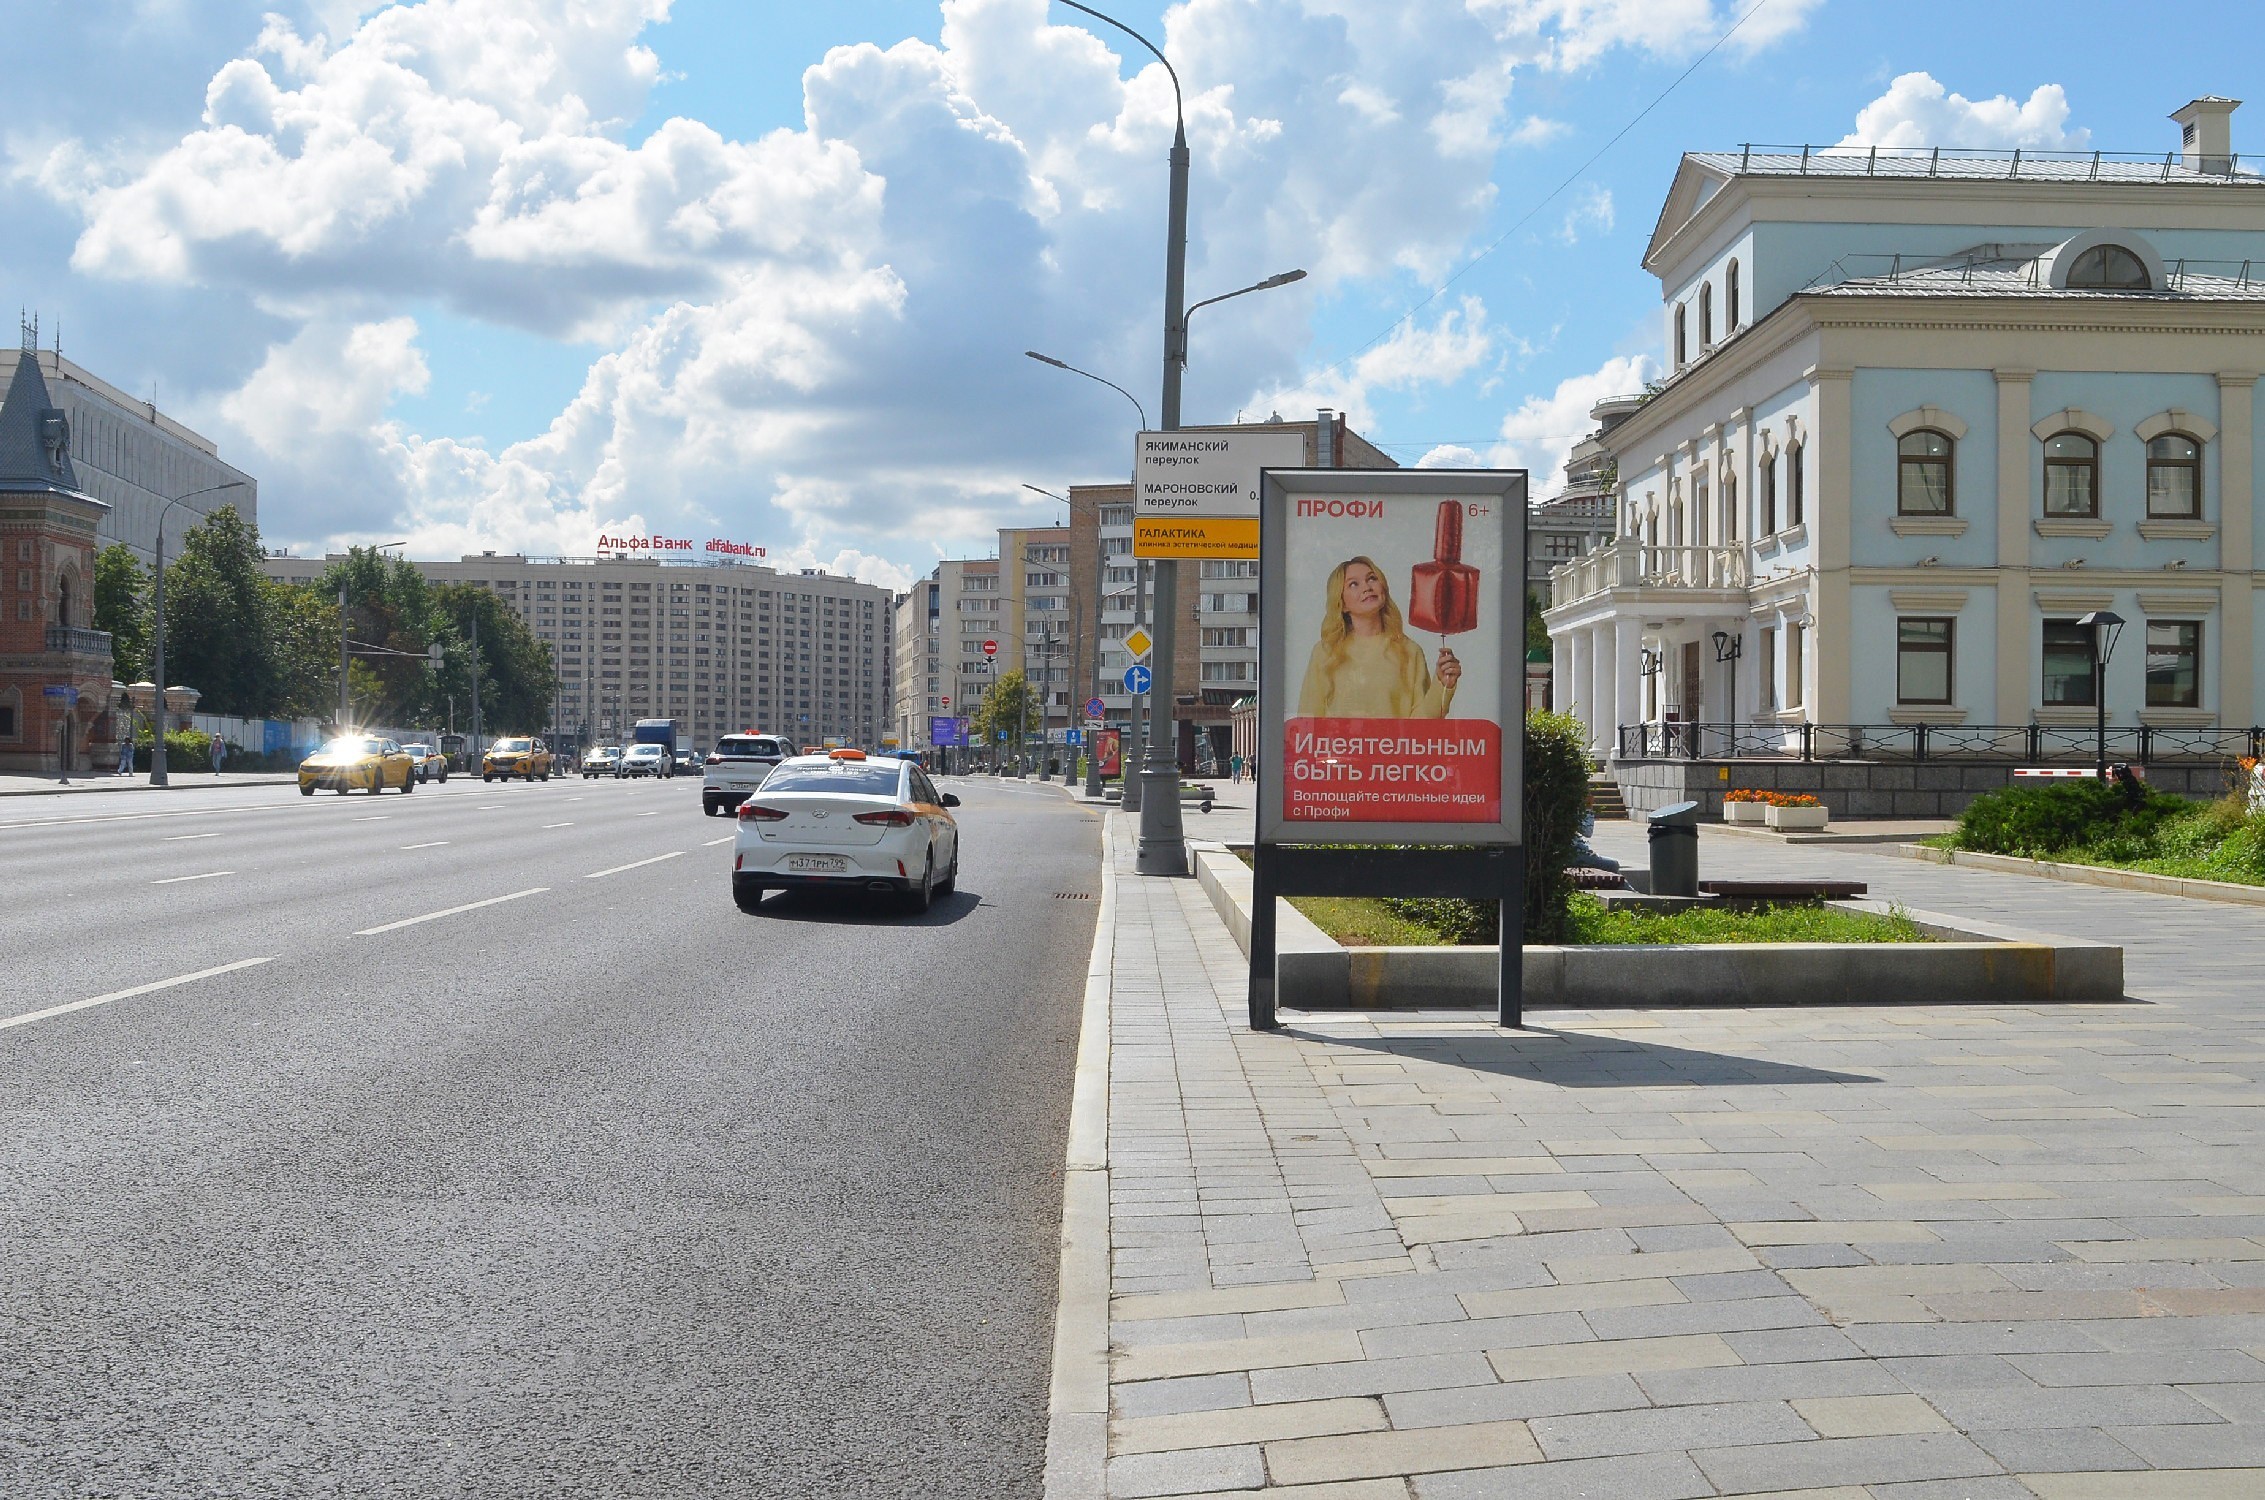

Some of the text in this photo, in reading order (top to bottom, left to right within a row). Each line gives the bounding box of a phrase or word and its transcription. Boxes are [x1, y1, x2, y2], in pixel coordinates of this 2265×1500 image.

[1145, 440, 1229, 452] ЯКИМАНСКИЙ
[1145, 456, 1200, 466] переулок
[1144, 482, 1259, 501] МАРОНОВСКИЙ 0.
[1144, 498, 1198, 508] переулок
[1297, 499, 1490, 518] ПРОФИ 6+
[1139, 529, 1206, 538] ГАЛАКТИКА
[598, 534, 693, 552] Альфа Банк
[705, 537, 766, 557] alfabank.ru
[1173, 541, 1226, 549] эстетической
[1295, 733, 1486, 758] Идеятельным
[1293, 759, 1447, 782] быть легко
[1293, 790, 1485, 805] Воплощайте стильные идеи
[1293, 805, 1350, 819] с Профи
